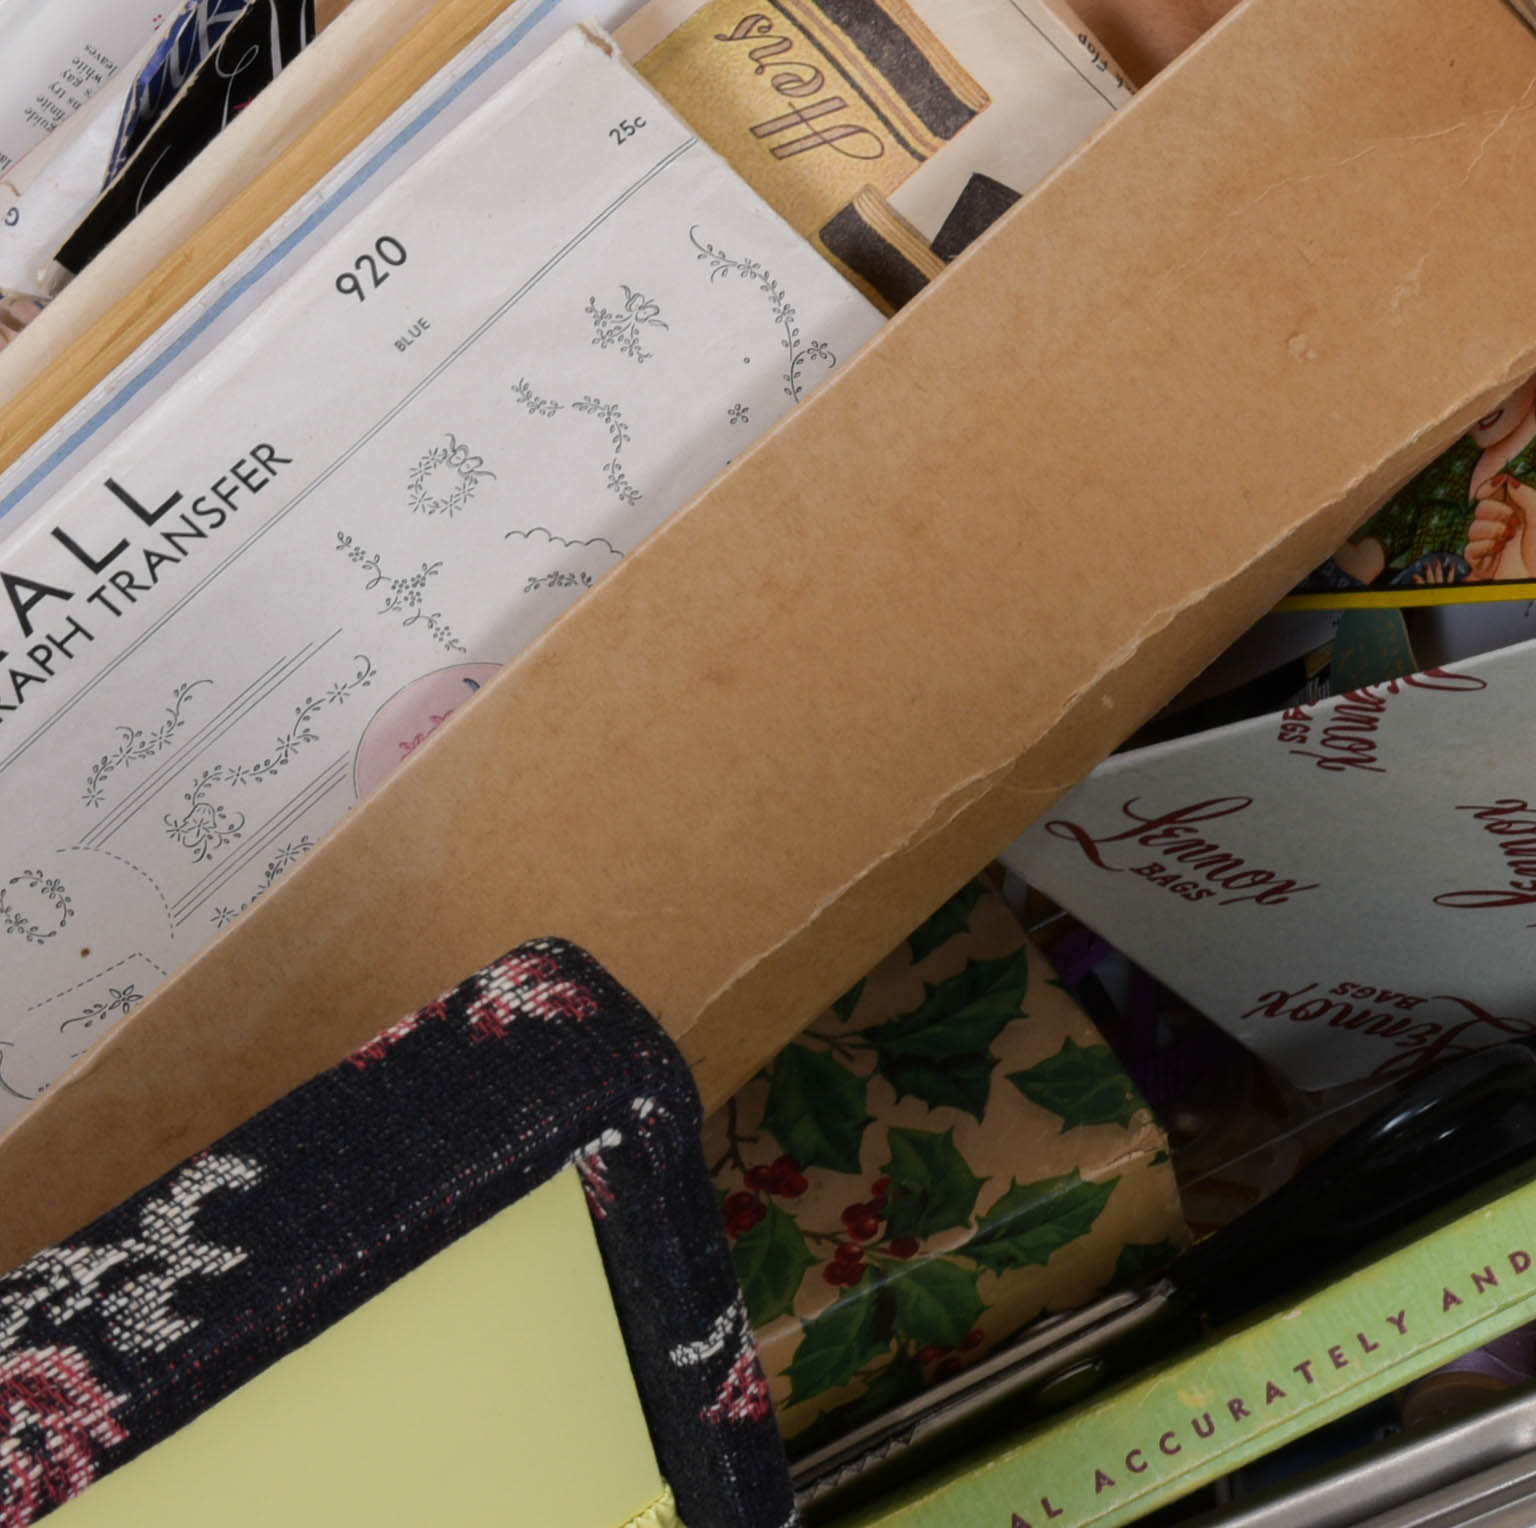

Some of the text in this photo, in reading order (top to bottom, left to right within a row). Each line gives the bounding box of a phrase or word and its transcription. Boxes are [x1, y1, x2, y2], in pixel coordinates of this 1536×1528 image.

[83, 43, 119, 78] leaves
[713, 10, 889, 165] Hers
[332, 232, 409, 306] 920
[393, 314, 433, 355] BLUE
[86, 438, 293, 626] TRANSFER
[1045, 795, 1321, 908] Lennox
[1128, 859, 1217, 906] BAGS
[1241, 986, 1536, 1076] Lennox
[1328, 980, 1420, 1013] BAGS
[1093, 1310, 1409, 1496] ACCURATELY
[1440, 1250, 1533, 1316] AND
